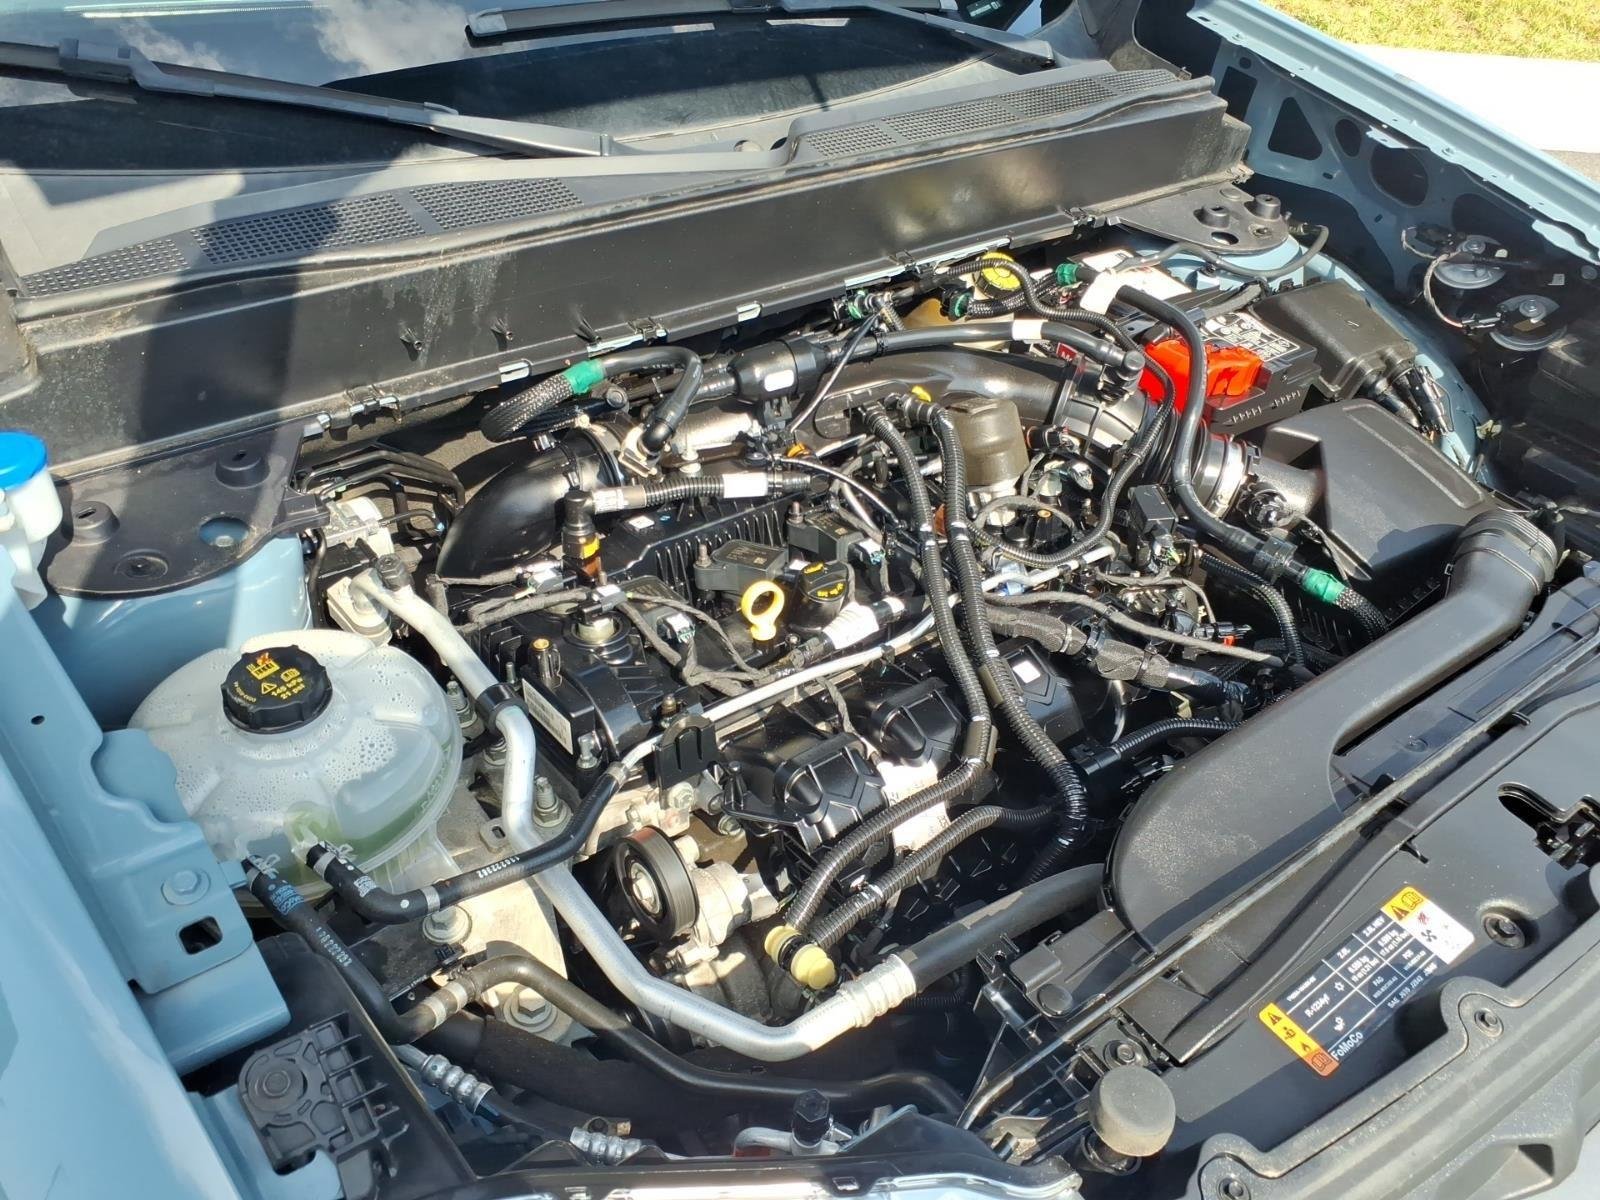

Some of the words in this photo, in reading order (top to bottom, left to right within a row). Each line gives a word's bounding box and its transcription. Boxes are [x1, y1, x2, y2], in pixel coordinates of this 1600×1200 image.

[1336, 947, 1351, 960] 2.0L
[1304, 993, 1330, 1018] R-1234yf
[1387, 996, 1400, 1008] SAE
[1330, 1031, 1364, 1061] FoMoCo
